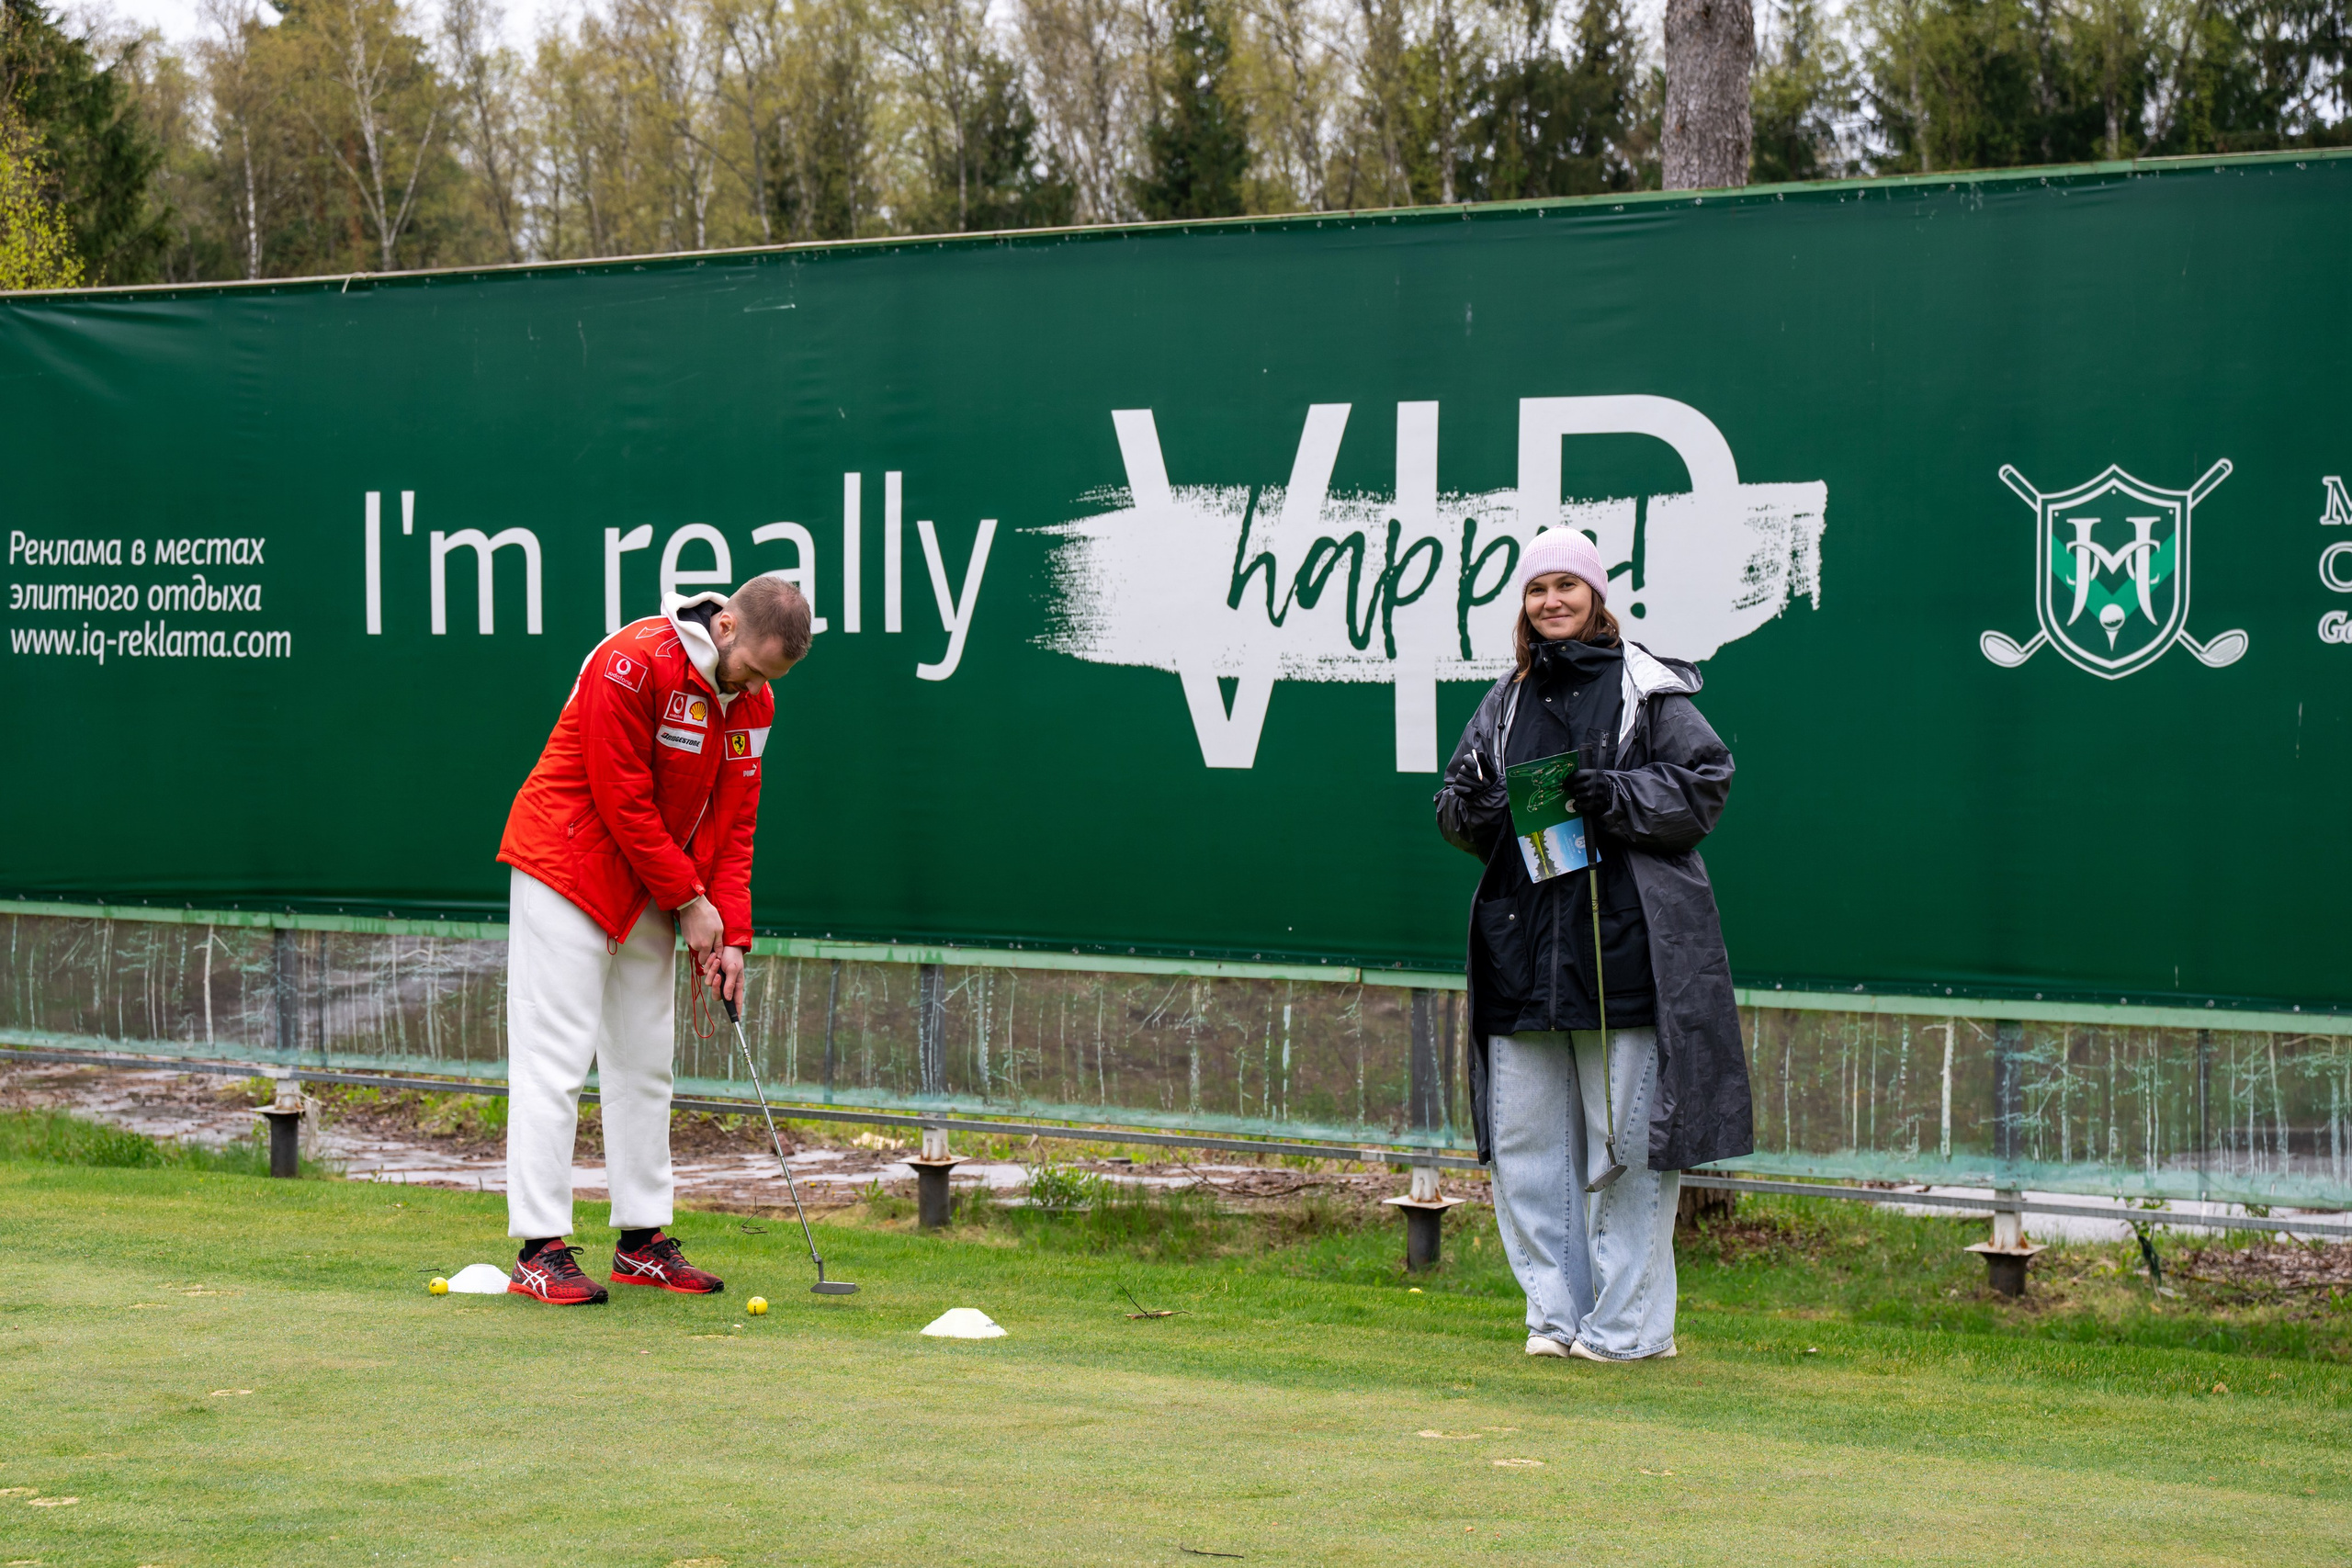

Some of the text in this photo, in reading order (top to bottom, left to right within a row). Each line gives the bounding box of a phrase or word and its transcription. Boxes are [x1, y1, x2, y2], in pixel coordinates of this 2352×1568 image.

[9, 530, 266, 566] Реклама в местах
[9, 573, 262, 613] элитного отдыха
[366, 470, 999, 682] I'm really
[1227, 485, 1648, 661] happ!
[10, 619, 291, 666] www.iq-reklama.com
[661, 732, 701, 748] BRIDGESTONE
